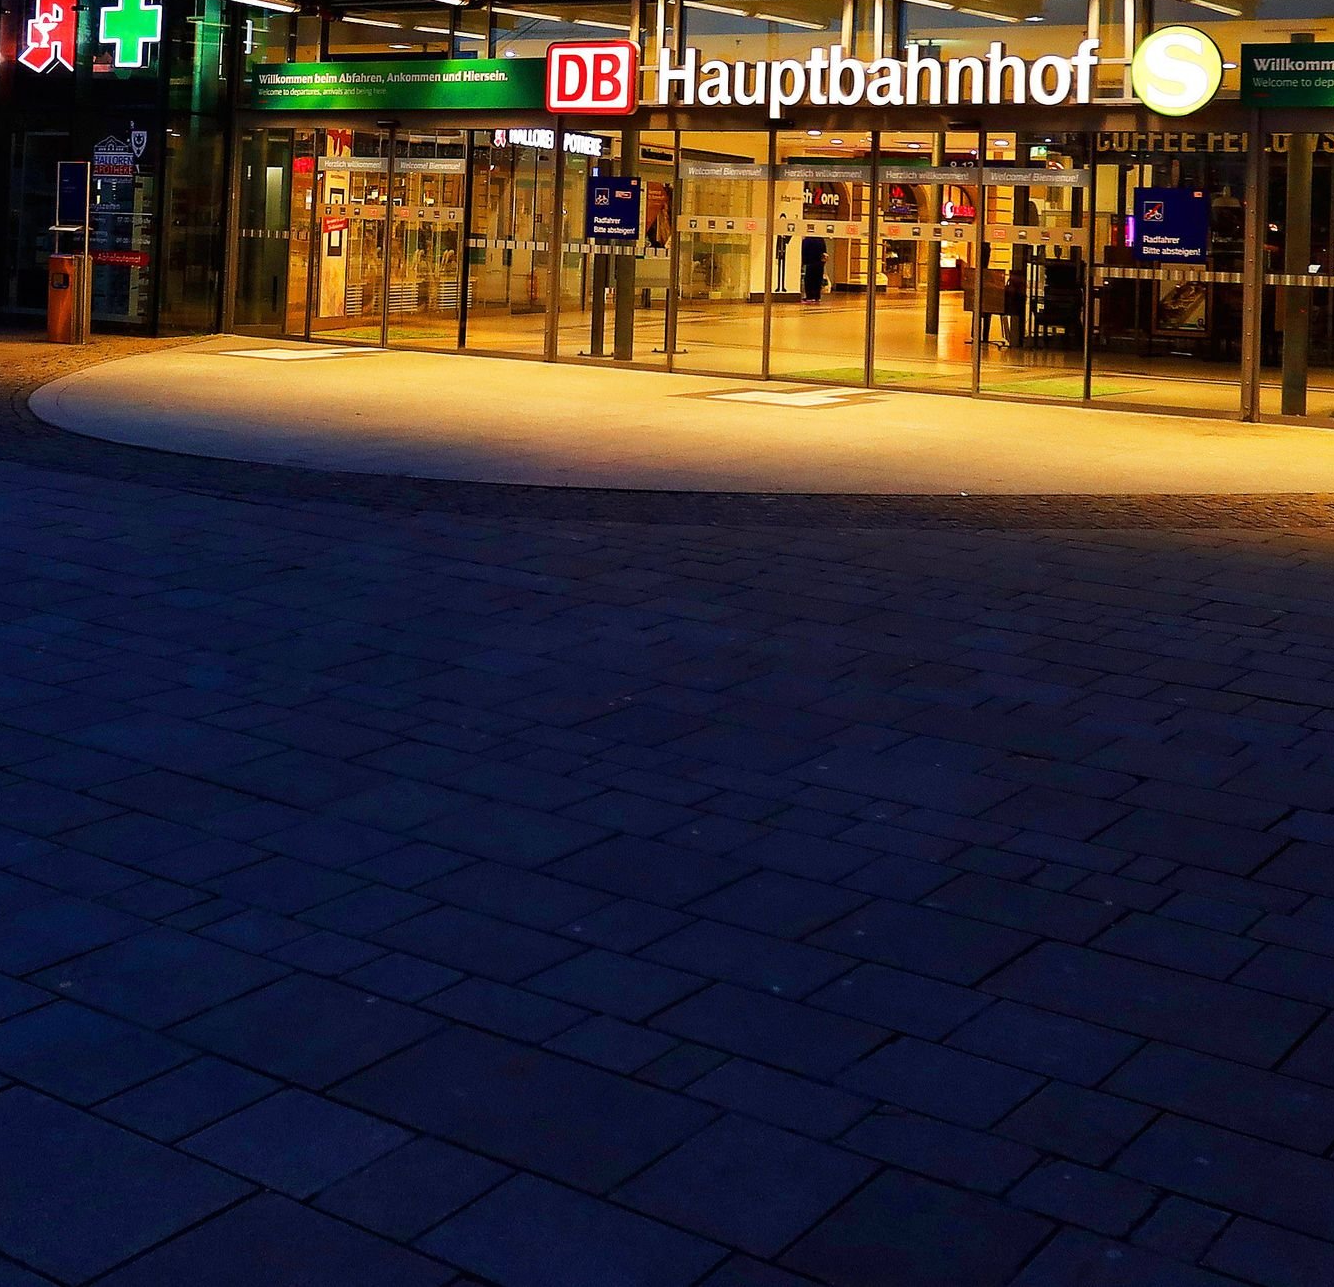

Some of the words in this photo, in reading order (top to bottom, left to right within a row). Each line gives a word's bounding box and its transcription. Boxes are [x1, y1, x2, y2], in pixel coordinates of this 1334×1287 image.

[1145, 33, 1209, 108] S
[259, 74, 313, 84] Willkommen
[315, 73, 337, 83] beim
[339, 73, 385, 84] Abfahren,
[387, 73, 441, 83] Ankommen
[443, 71, 462, 82] und
[463, 70, 508, 81] Hiersein.
[557, 54, 622, 102] DB
[659, 39, 1099, 118] Hauptbahnhof
[1252, 77, 1298, 88] Welcome
[1300, 78, 1312, 87] to
[563, 133, 602, 156] POTHEKE
[93, 155, 134, 164] HALLOREN
[689, 166, 723, 176] Welcome!
[723, 167, 762, 177] Bienvenue!
[784, 168, 813, 178] Herzlich
[815, 169, 862, 179] willkommen!
[886, 170, 917, 180] Herzlich
[919, 170, 969, 181] willkommen!
[991, 172, 1030, 182] Welcome!
[1032, 172, 1079, 183] Bienvenue!
[594, 216, 621, 225] Radfahrer
[1143, 235, 1180, 244] Radfahrer
[1143, 246, 1161, 255] Bitte
[1161, 246, 1201, 258] absteigen!
